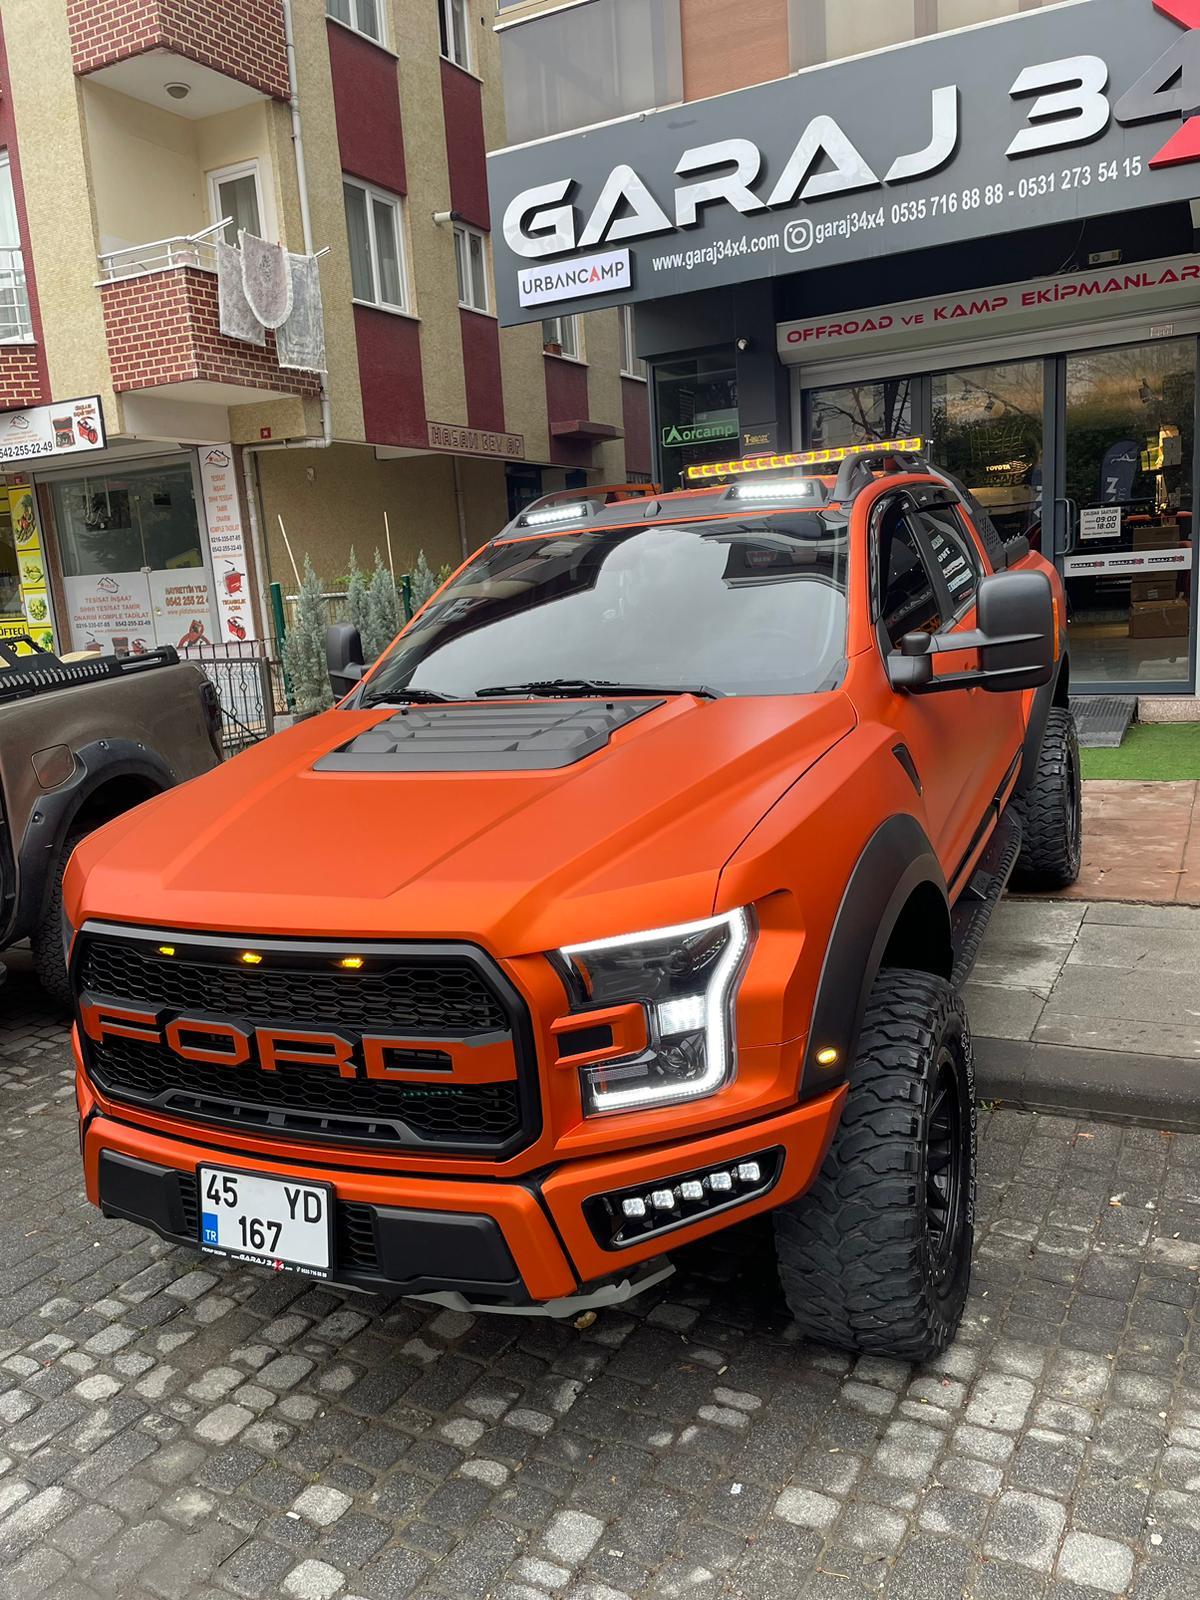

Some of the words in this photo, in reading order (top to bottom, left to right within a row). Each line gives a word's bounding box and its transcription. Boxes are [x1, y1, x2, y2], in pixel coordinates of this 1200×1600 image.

[503, 85, 959, 260] GARAJ
[652, 231, 780, 272] www.garaj34x4.com
[815, 207, 885, 244] garaj34x4
[891, 197, 927, 225] 0535
[930, 192, 958, 217] 716
[961, 188, 981, 210] 88
[984, 183, 1004, 205] 88
[1017, 172, 1056, 200] 0531
[1060, 165, 1092, 191] 273
[1097, 161, 1118, 183] 54
[1122, 155, 1142, 178] 15
[522, 261, 625, 294] URBANCAMP
[786, 315, 894, 344] OFFROAD
[932, 296, 1009, 321] KAMP
[1020, 264, 1200, 307] EKİPMANLAR
[78, 994, 519, 1085] FORD
[206, 1173, 238, 1208] 45
[283, 1186, 322, 1223] YD
[205, 1229, 217, 1241] TR
[238, 1215, 283, 1253] 167
